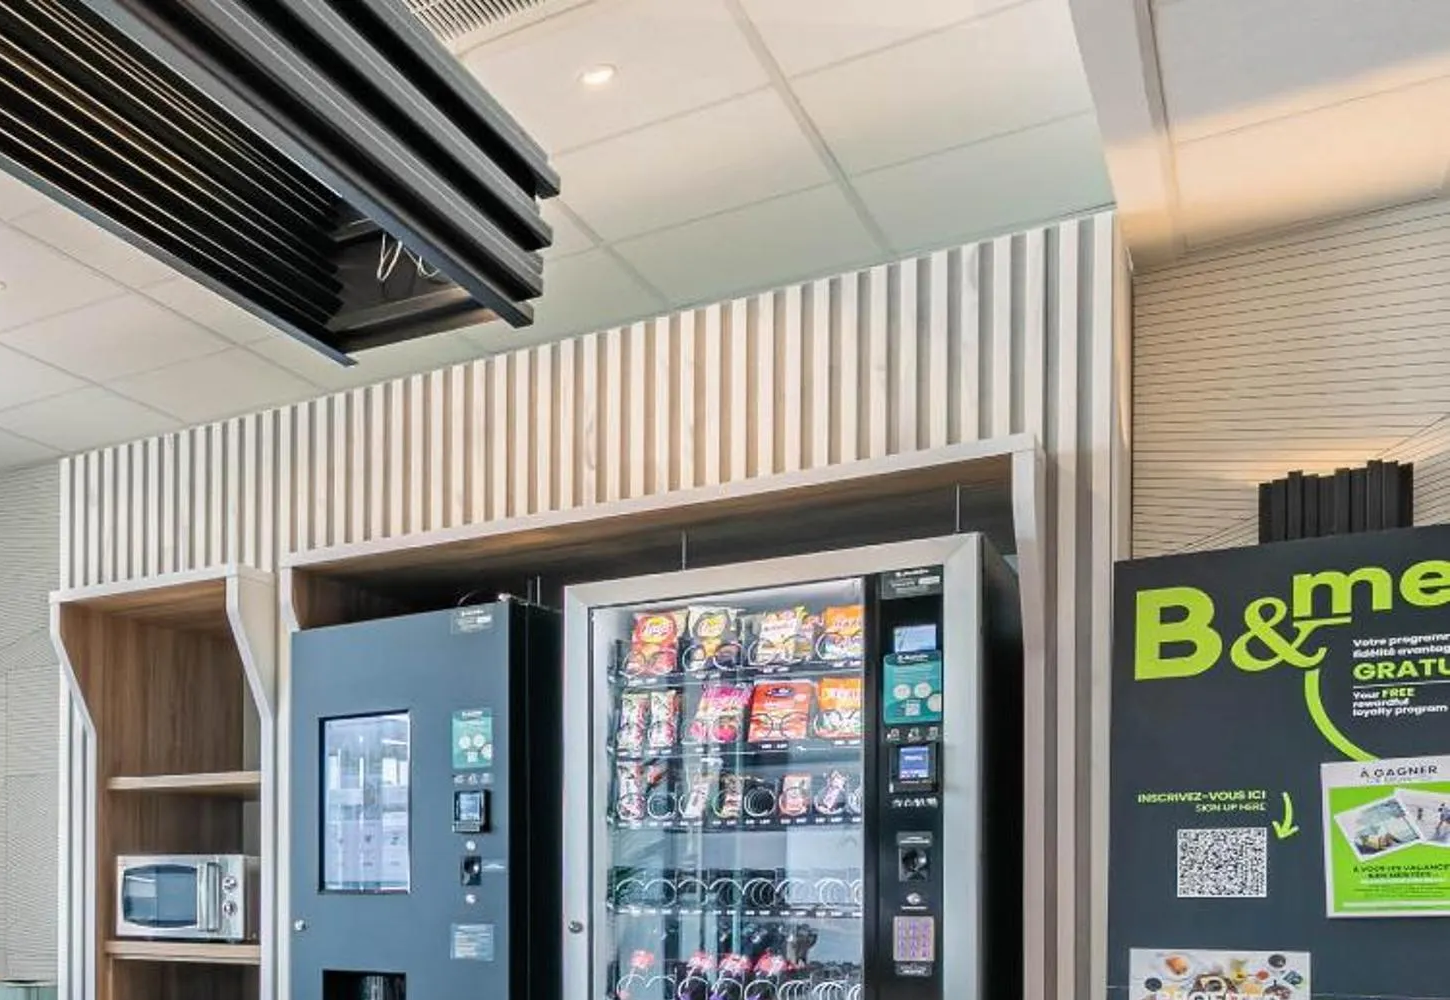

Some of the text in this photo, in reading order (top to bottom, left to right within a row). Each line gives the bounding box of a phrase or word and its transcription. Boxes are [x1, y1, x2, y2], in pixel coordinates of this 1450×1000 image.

[1134, 560, 1450, 681] B&me
[1353, 638, 1387, 647] Votre
[1353, 687, 1416, 699] Your FREE
[1353, 704, 1449, 718] loyalty program
[1373, 765, 1438, 778] GAGNER
[1248, 789, 1266, 800] ICI
[1223, 803, 1238, 811] UP
